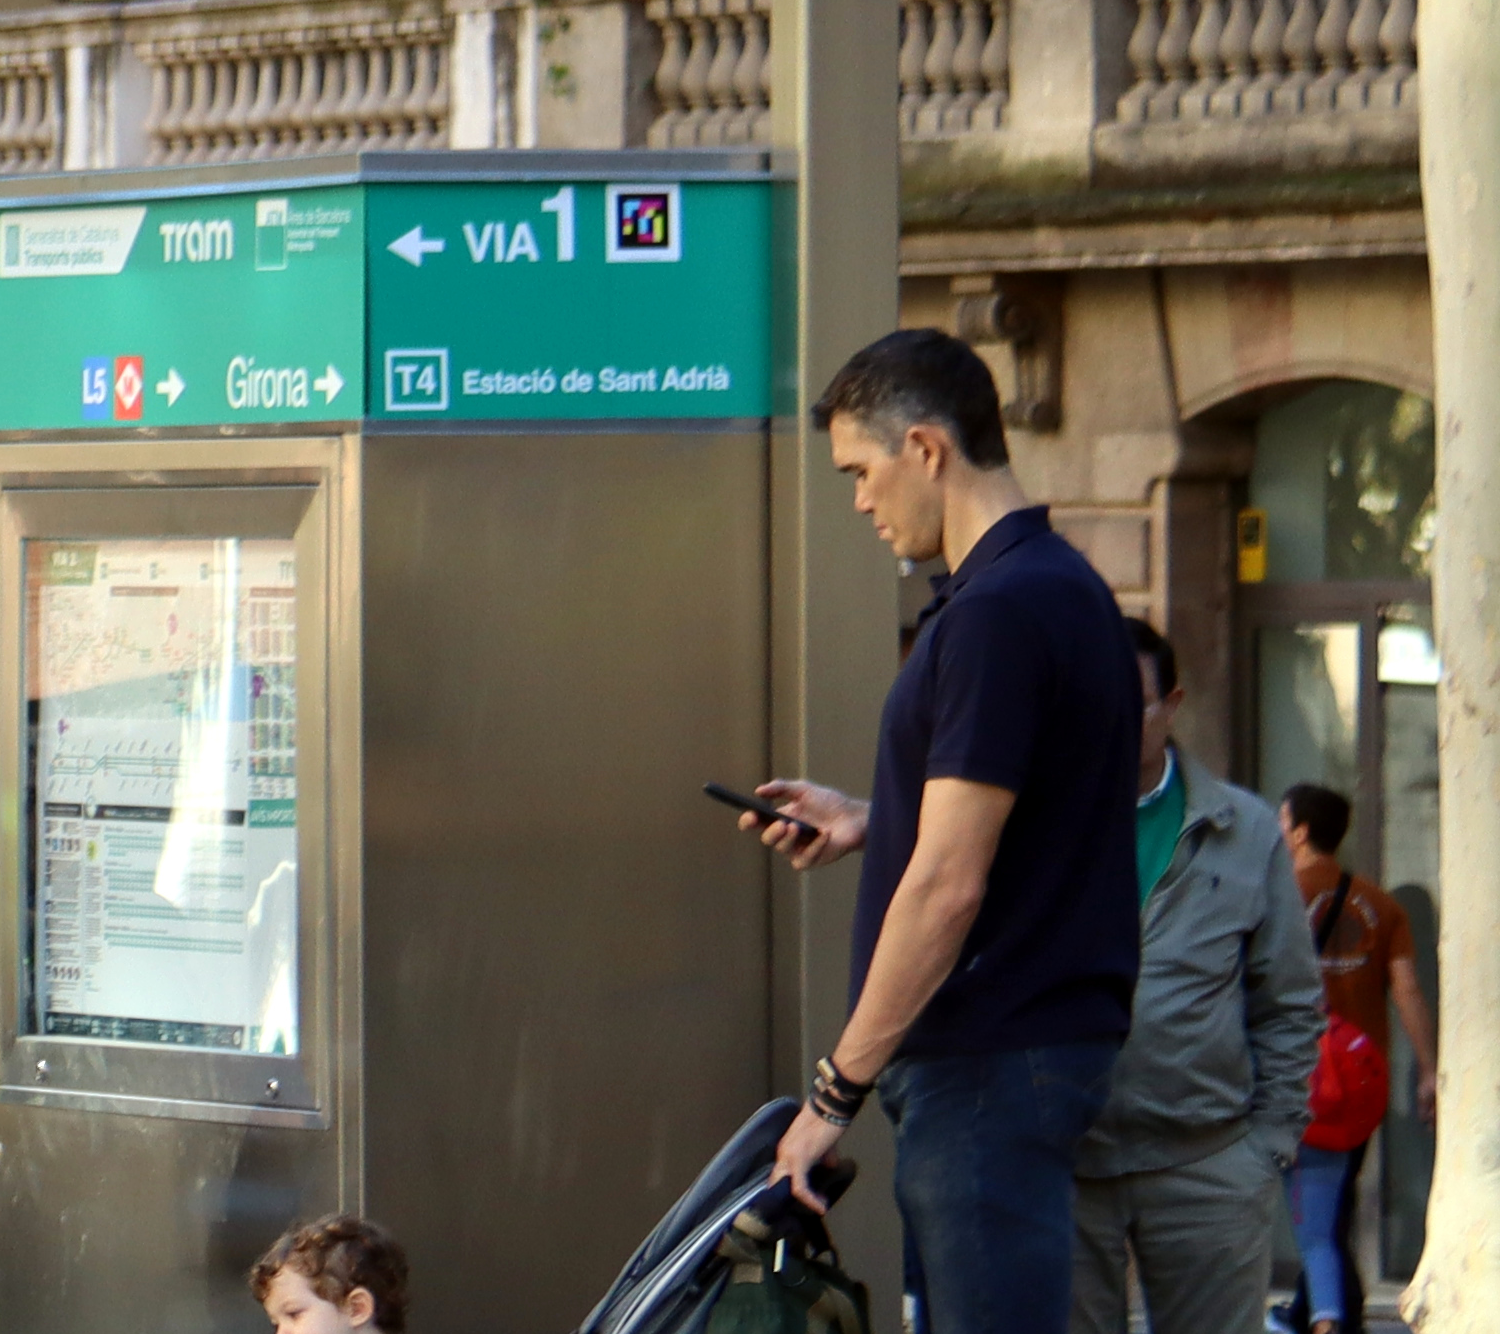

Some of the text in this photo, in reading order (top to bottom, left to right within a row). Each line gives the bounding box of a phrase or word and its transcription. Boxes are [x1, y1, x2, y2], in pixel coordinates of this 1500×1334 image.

[462, 185, 576, 263] VIA 1
[82, 367, 108, 405] L5
[226, 354, 310, 410] Girona
[394, 364, 731, 397] T4 Estació de Sant Adrià
